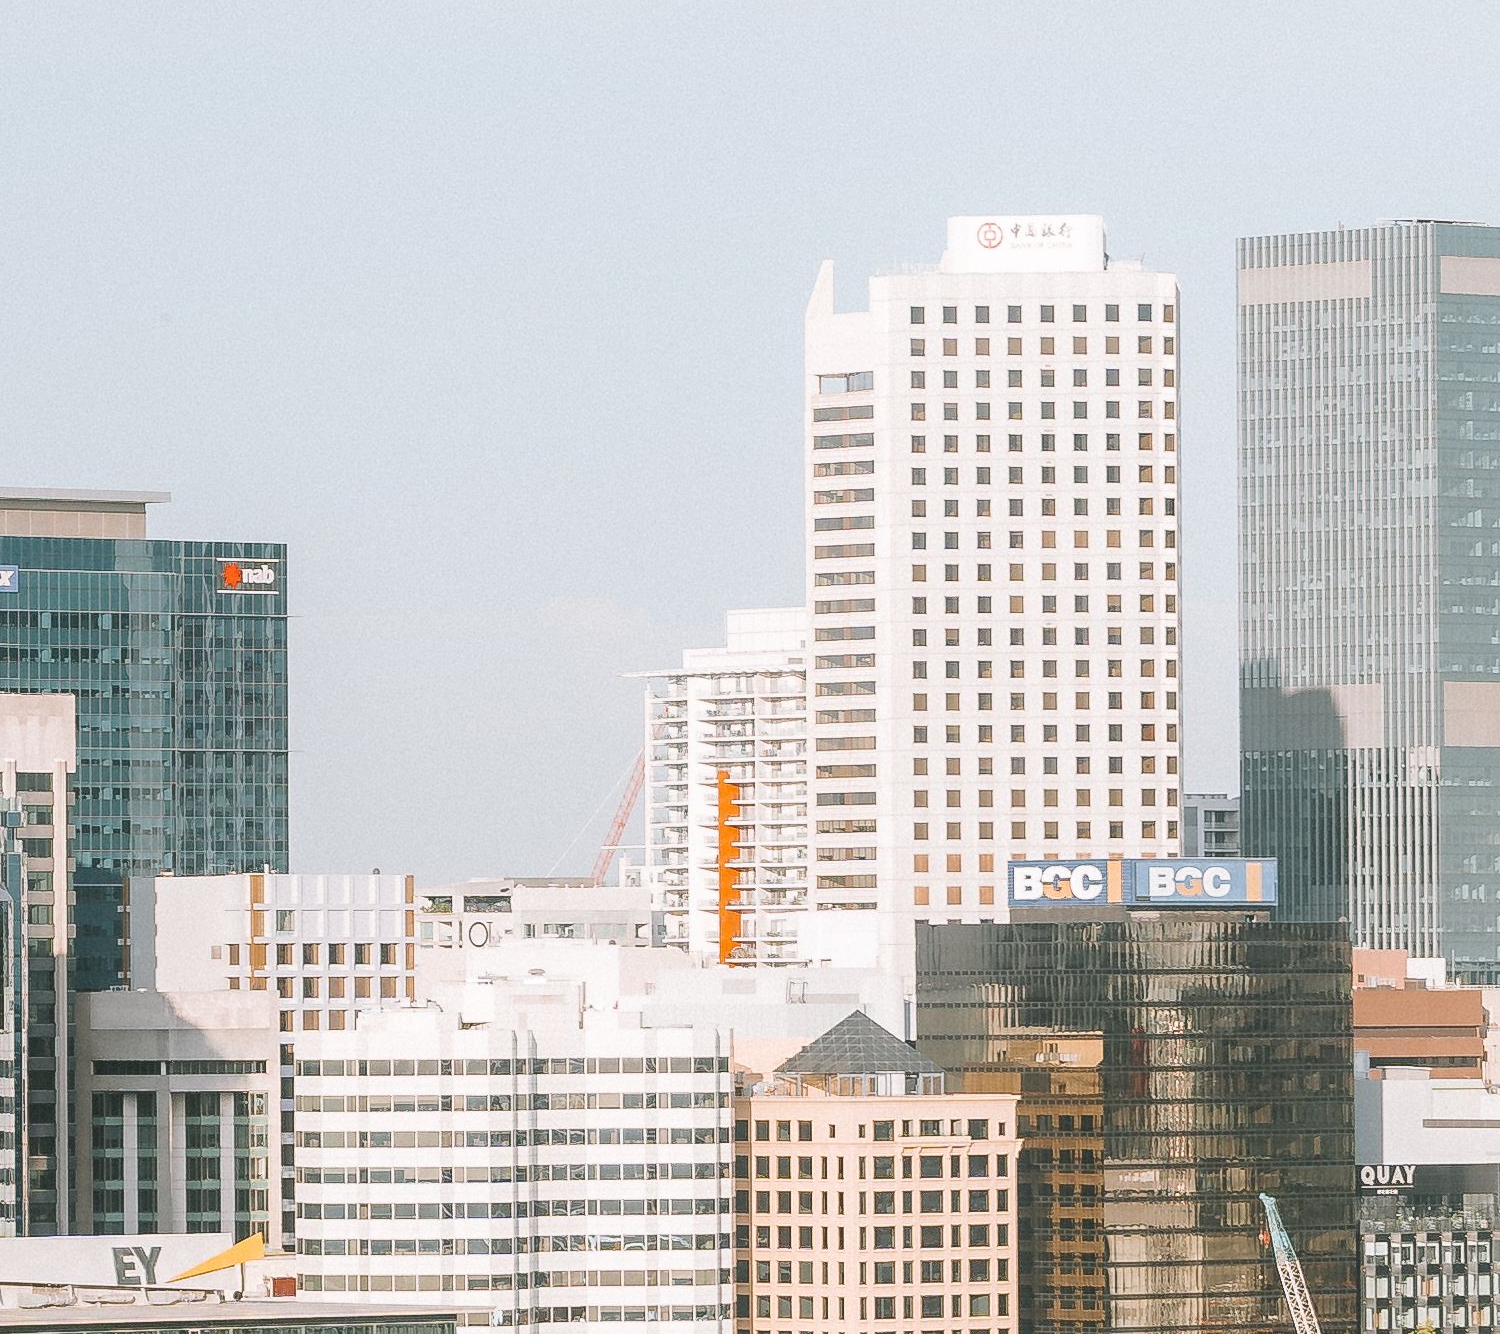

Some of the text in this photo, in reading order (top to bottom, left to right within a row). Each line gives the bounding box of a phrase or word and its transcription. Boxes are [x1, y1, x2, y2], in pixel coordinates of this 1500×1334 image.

[242, 564, 275, 584] nab
[1013, 865, 1104, 901] BGC
[1149, 866, 1232, 898] BGC
[1360, 1165, 1416, 1186] QUAY
[112, 1247, 161, 1285] EY
